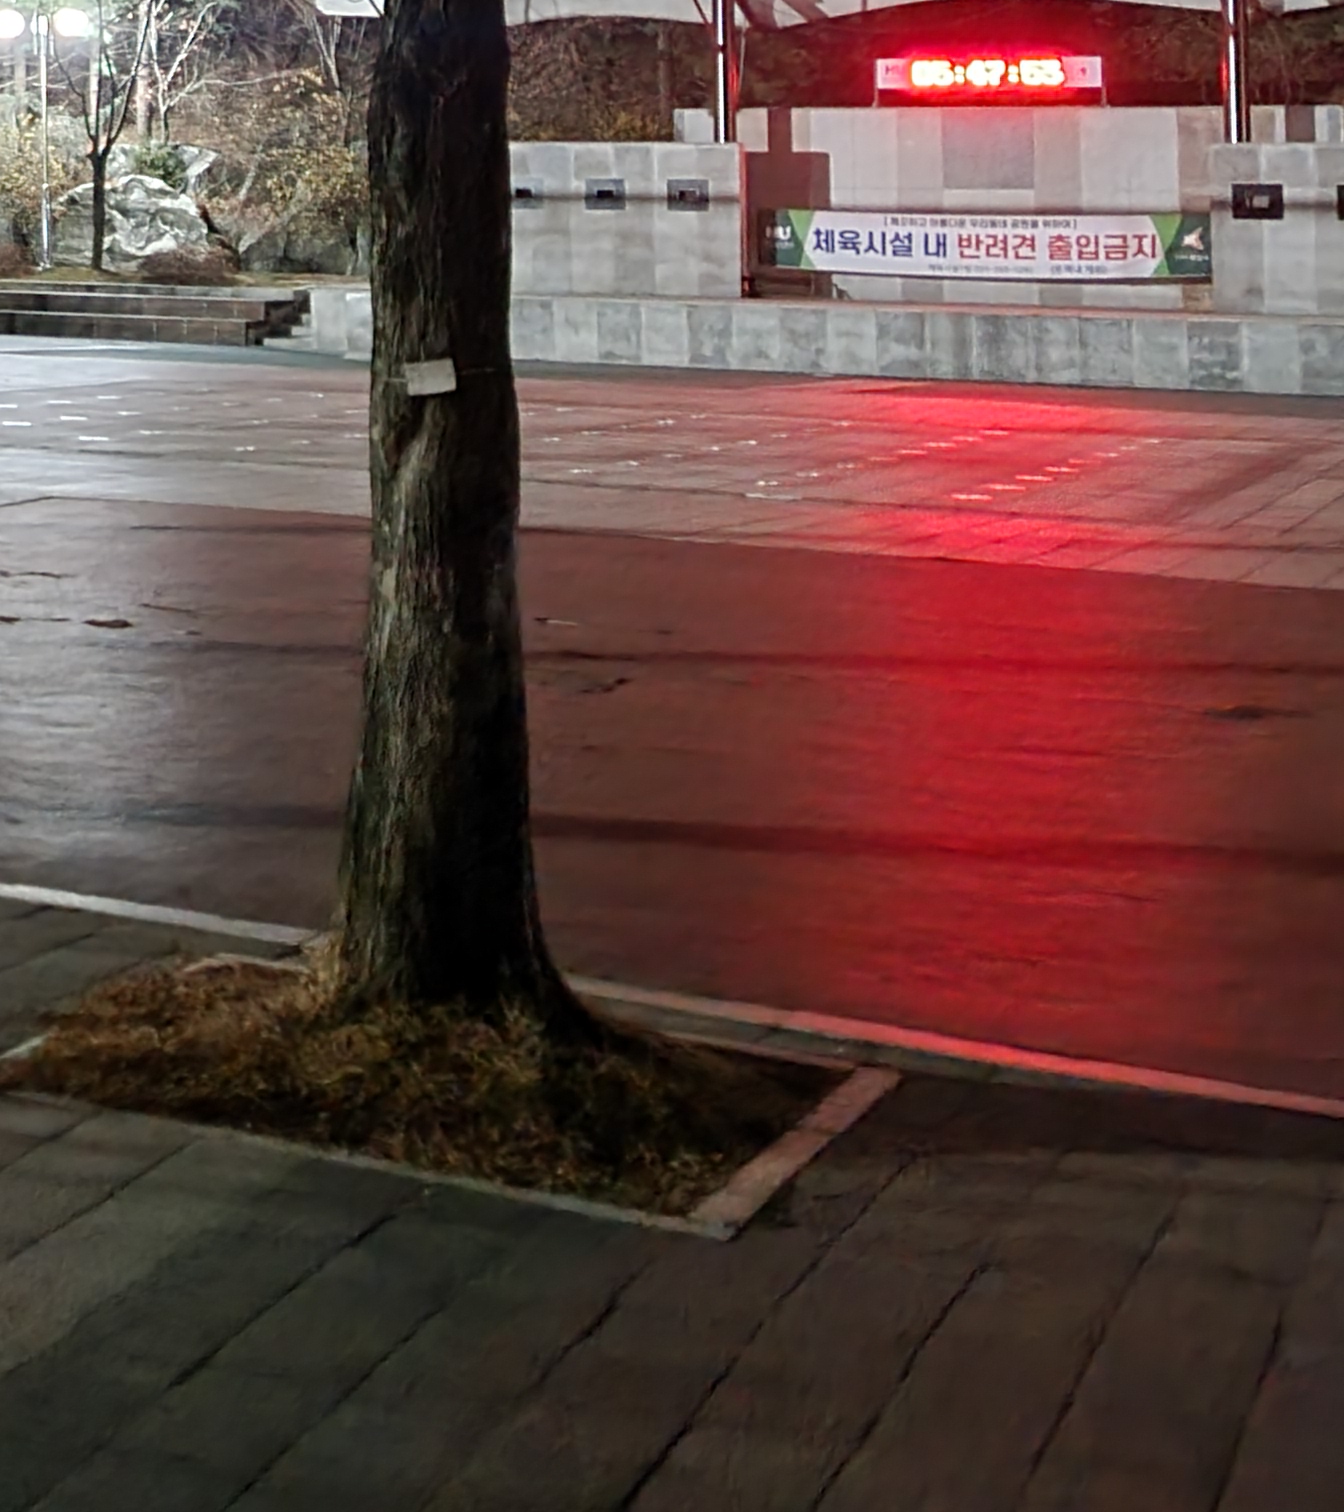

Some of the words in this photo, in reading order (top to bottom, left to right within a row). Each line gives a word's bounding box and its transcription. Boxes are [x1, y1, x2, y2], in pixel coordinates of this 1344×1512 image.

[813, 227, 914, 258] 체육시설
[924, 232, 948, 259] 내
[957, 233, 1037, 260] 반려견
[1047, 233, 1158, 261] 출입금지
